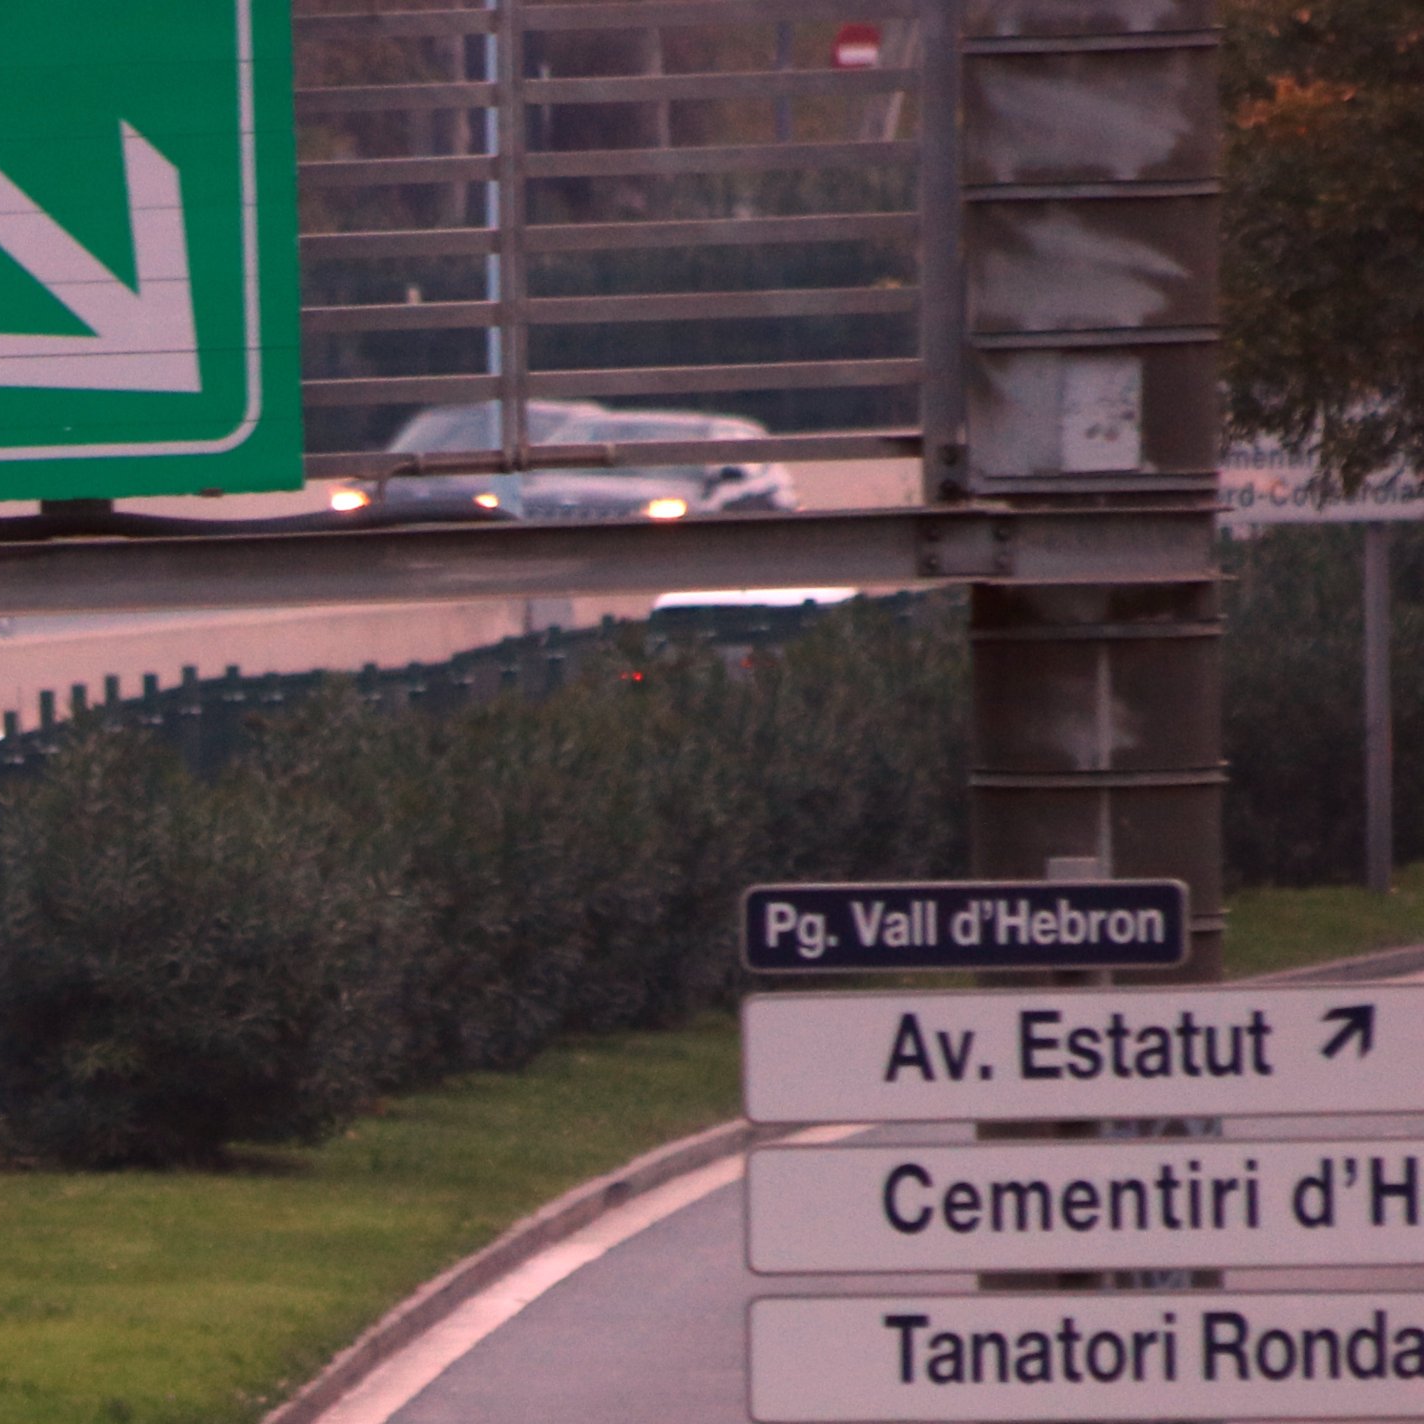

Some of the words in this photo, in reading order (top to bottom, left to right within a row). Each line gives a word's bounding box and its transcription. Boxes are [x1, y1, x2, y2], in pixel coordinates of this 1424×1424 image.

[766, 902, 838, 959] Pg.
[851, 901, 937, 947] Vall
[951, 899, 1164, 946] d'Hebron
[884, 1012, 993, 1082] Av.
[1019, 1010, 1272, 1080] Estatut
[883, 1159, 1259, 1235] Cementiri
[884, 1312, 1176, 1385] Tanatori
[1202, 1309, 1424, 1381] Ronda
